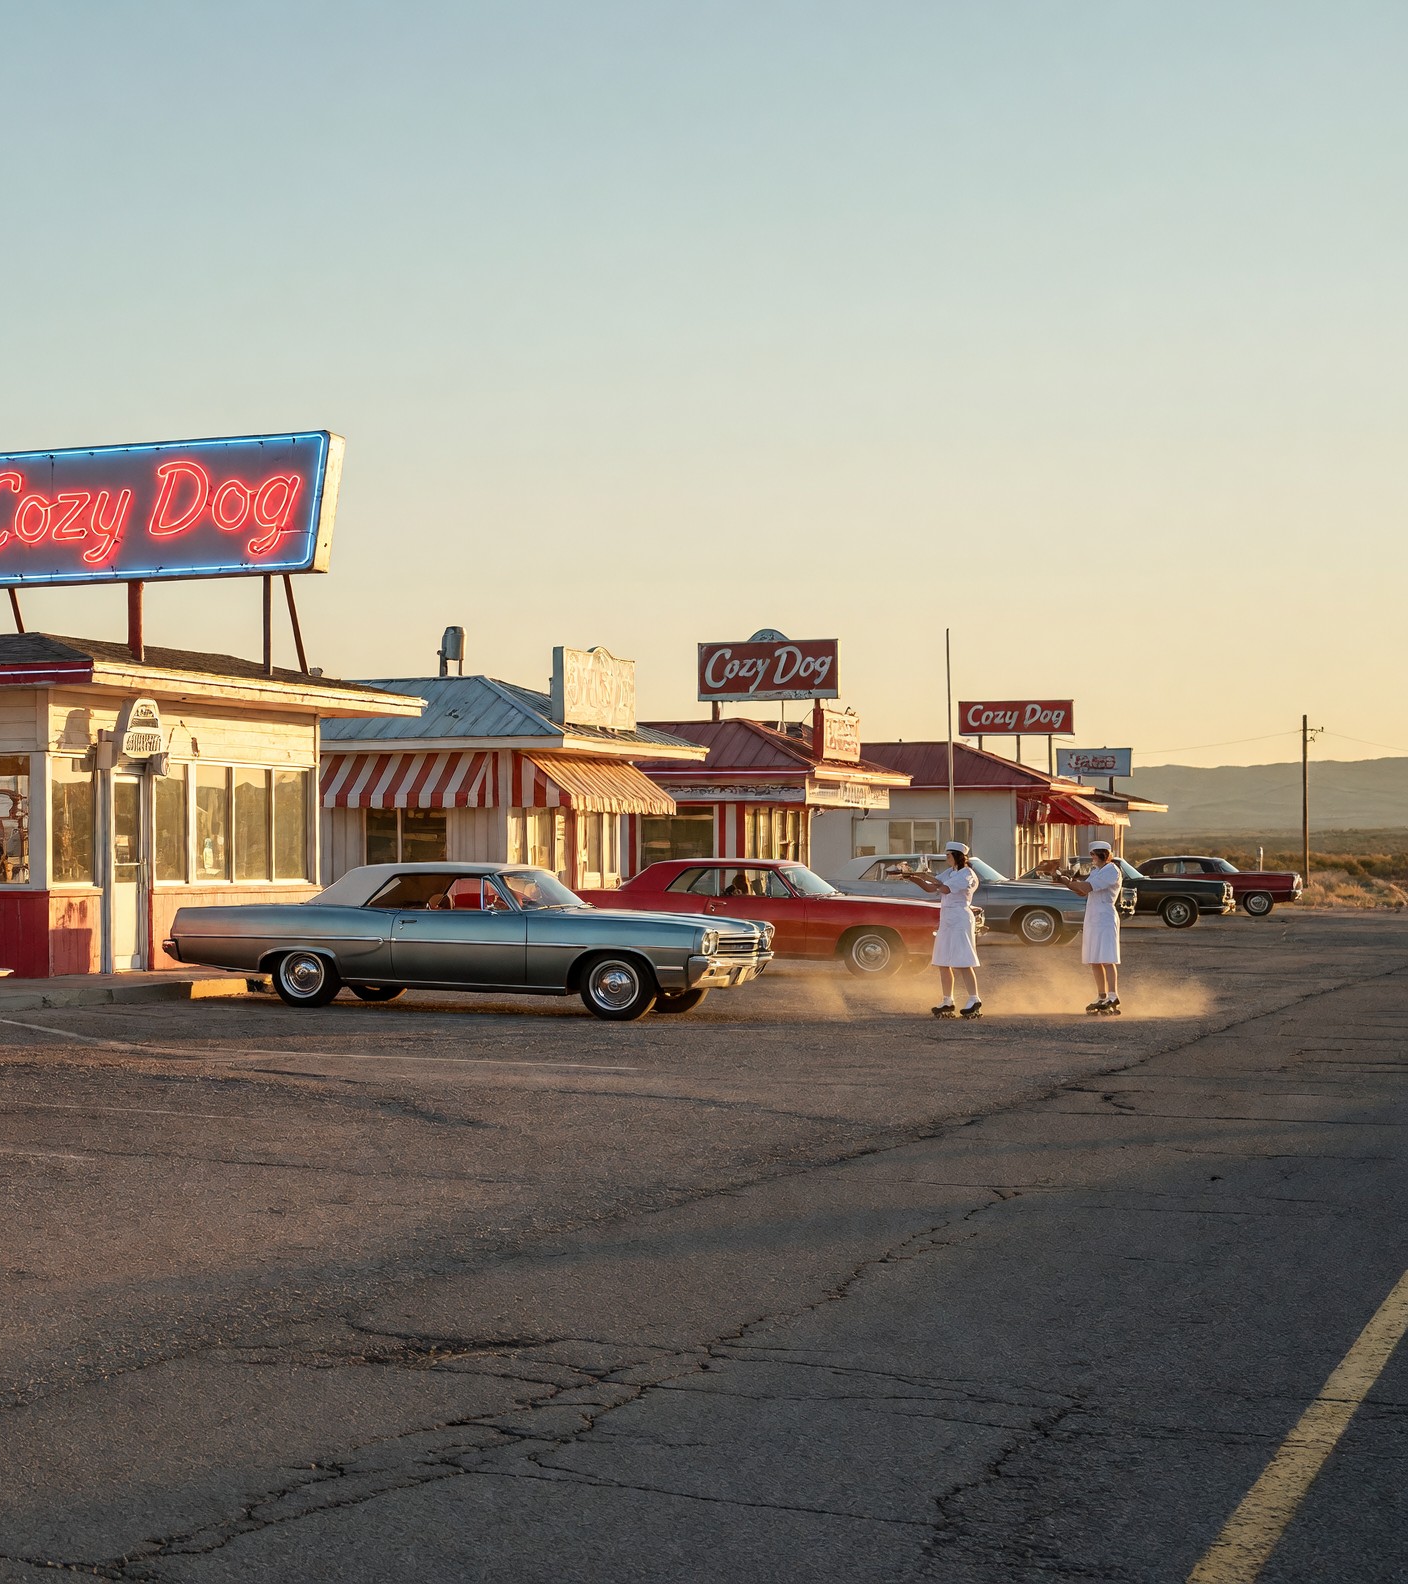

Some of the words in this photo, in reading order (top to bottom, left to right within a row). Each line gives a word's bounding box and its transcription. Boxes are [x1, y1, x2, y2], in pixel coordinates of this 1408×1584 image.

[148, 460, 300, 556] Dog
[705, 648, 770, 694] Cozy
[773, 645, 833, 685] Dog
[967, 704, 1019, 729] Cozy
[1023, 703, 1066, 729] Dog
